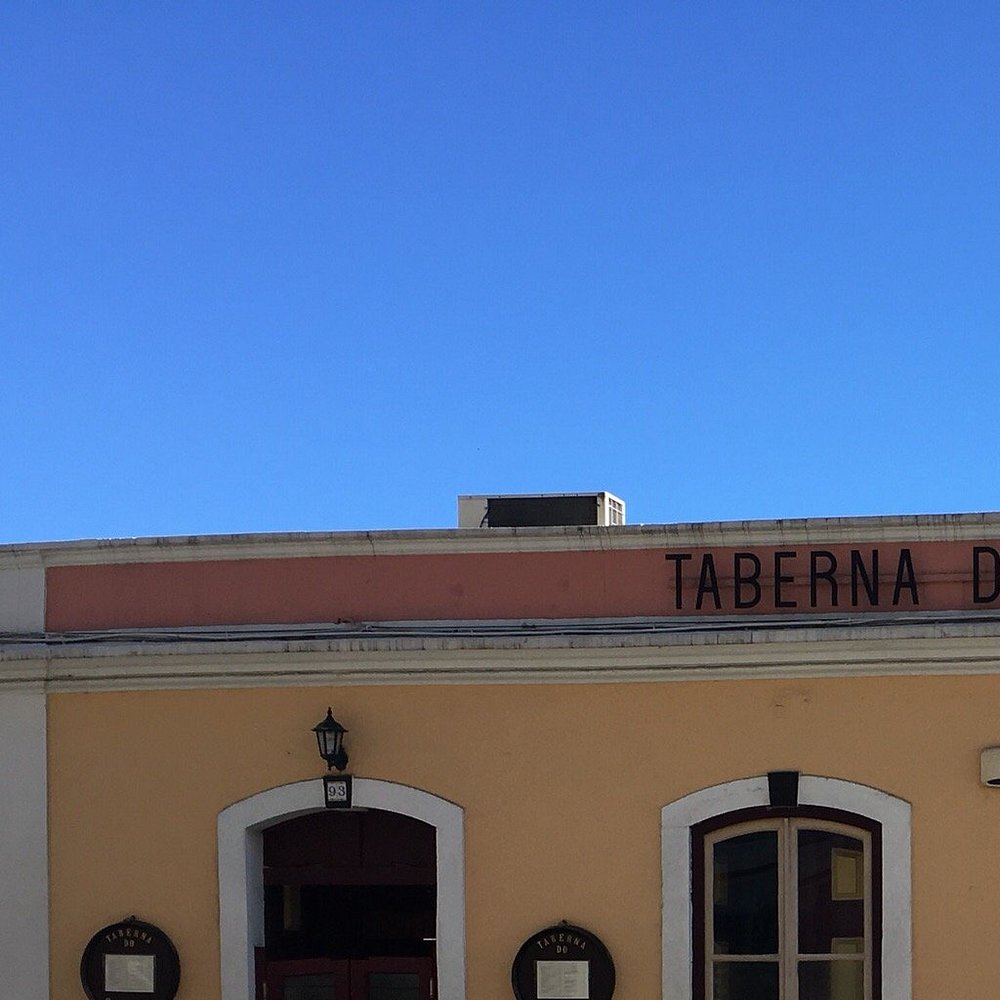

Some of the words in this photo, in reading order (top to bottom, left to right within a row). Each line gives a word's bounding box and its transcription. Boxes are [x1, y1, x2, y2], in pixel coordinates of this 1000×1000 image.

[665, 548, 920, 610] TABERNA
[105, 928, 153, 944] TABERNA
[123, 939, 135, 948] DO
[537, 933, 587, 950] TABERNA
[556, 945, 568, 954] DO
